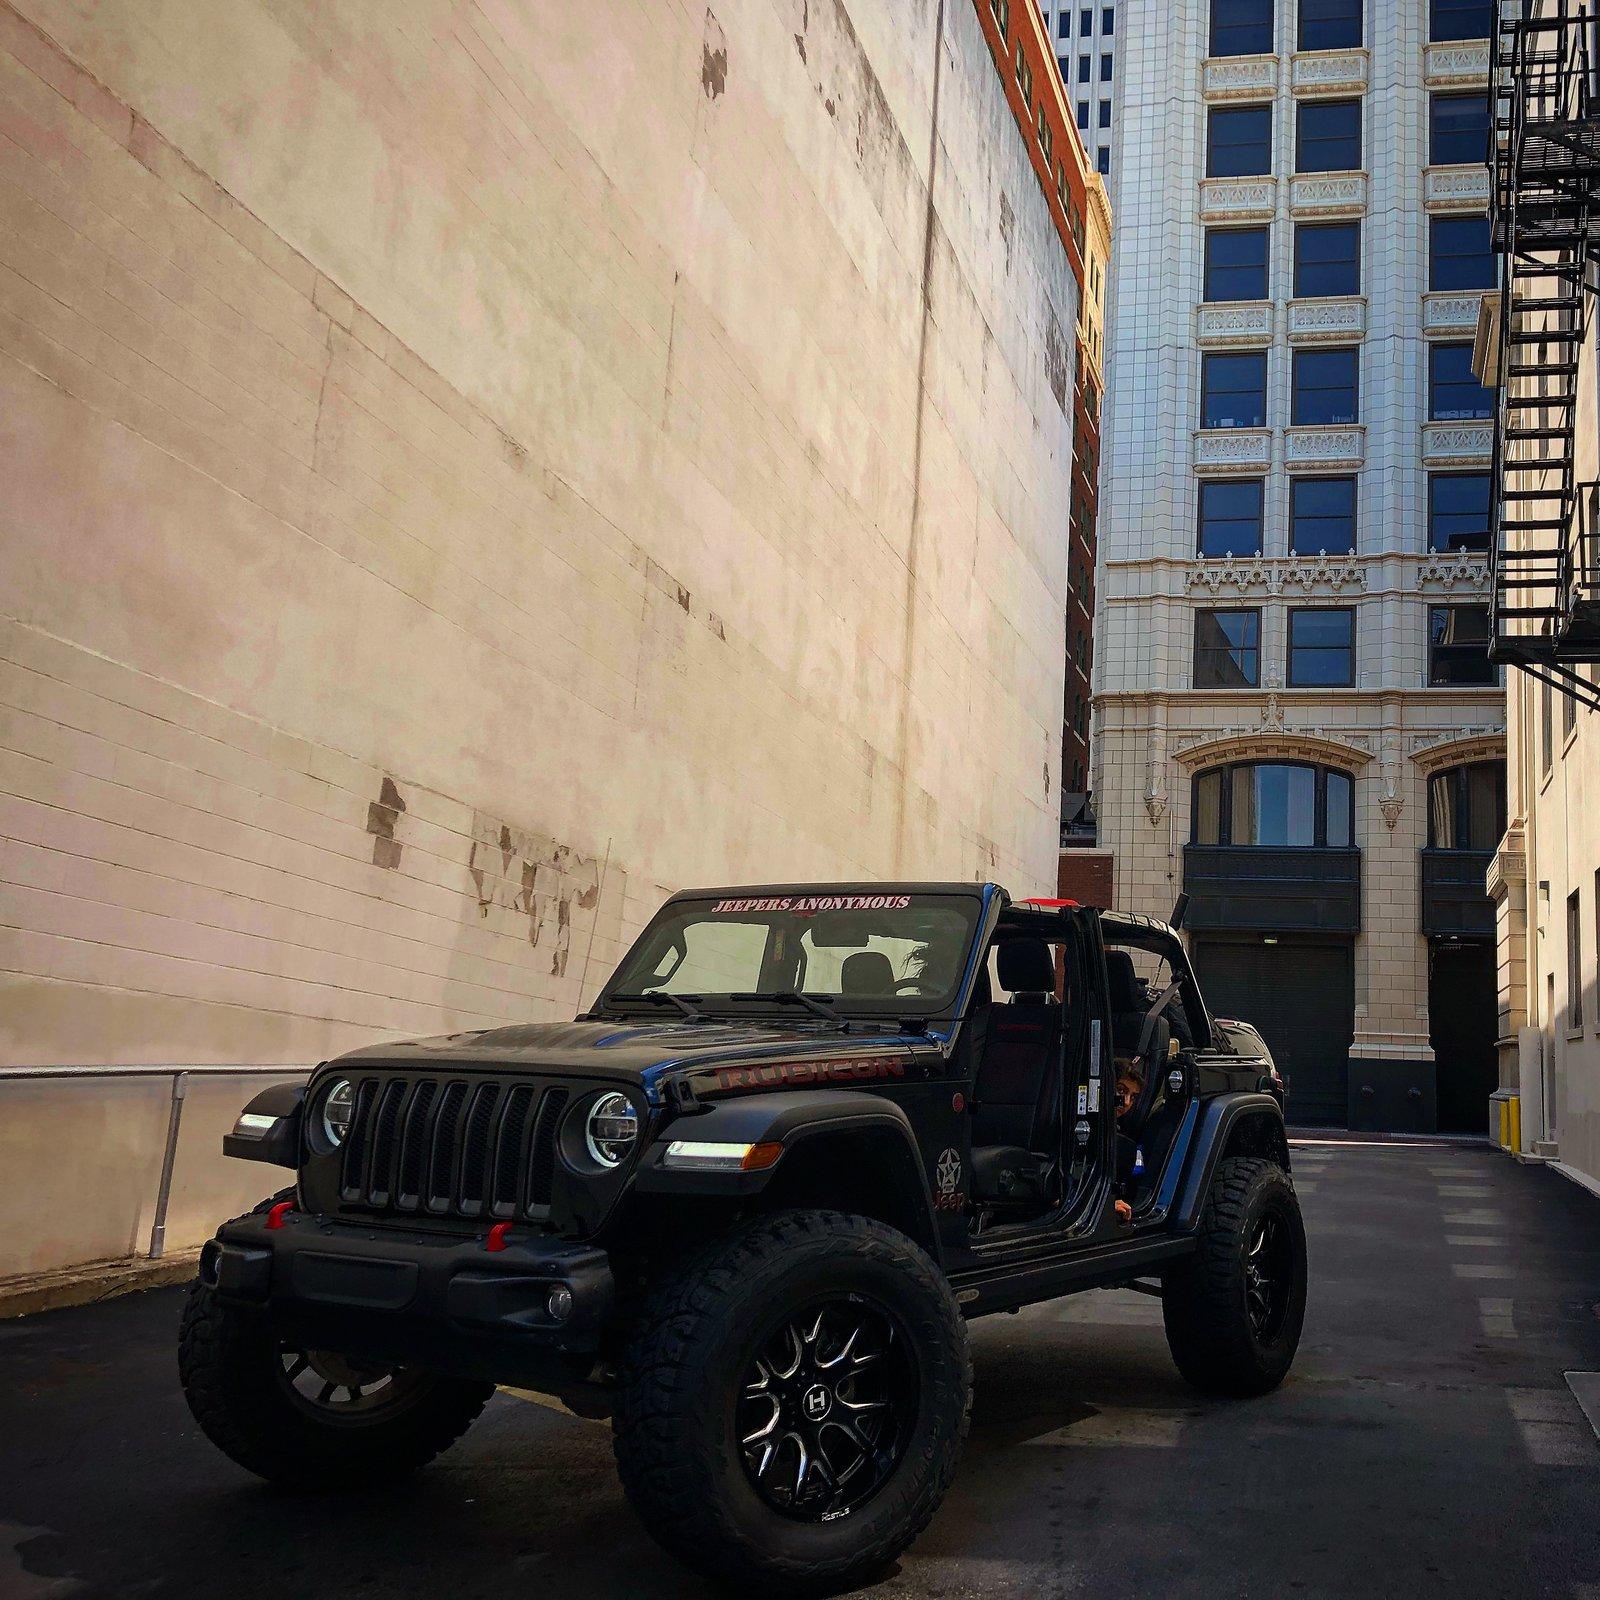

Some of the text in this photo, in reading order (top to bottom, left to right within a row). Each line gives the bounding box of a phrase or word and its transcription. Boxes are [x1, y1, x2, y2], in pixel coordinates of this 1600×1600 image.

[711, 896, 911, 913] JEEPERS ANONYMOUS
[717, 1056, 905, 1089] RUBICON
[809, 1391, 825, 1410] H
